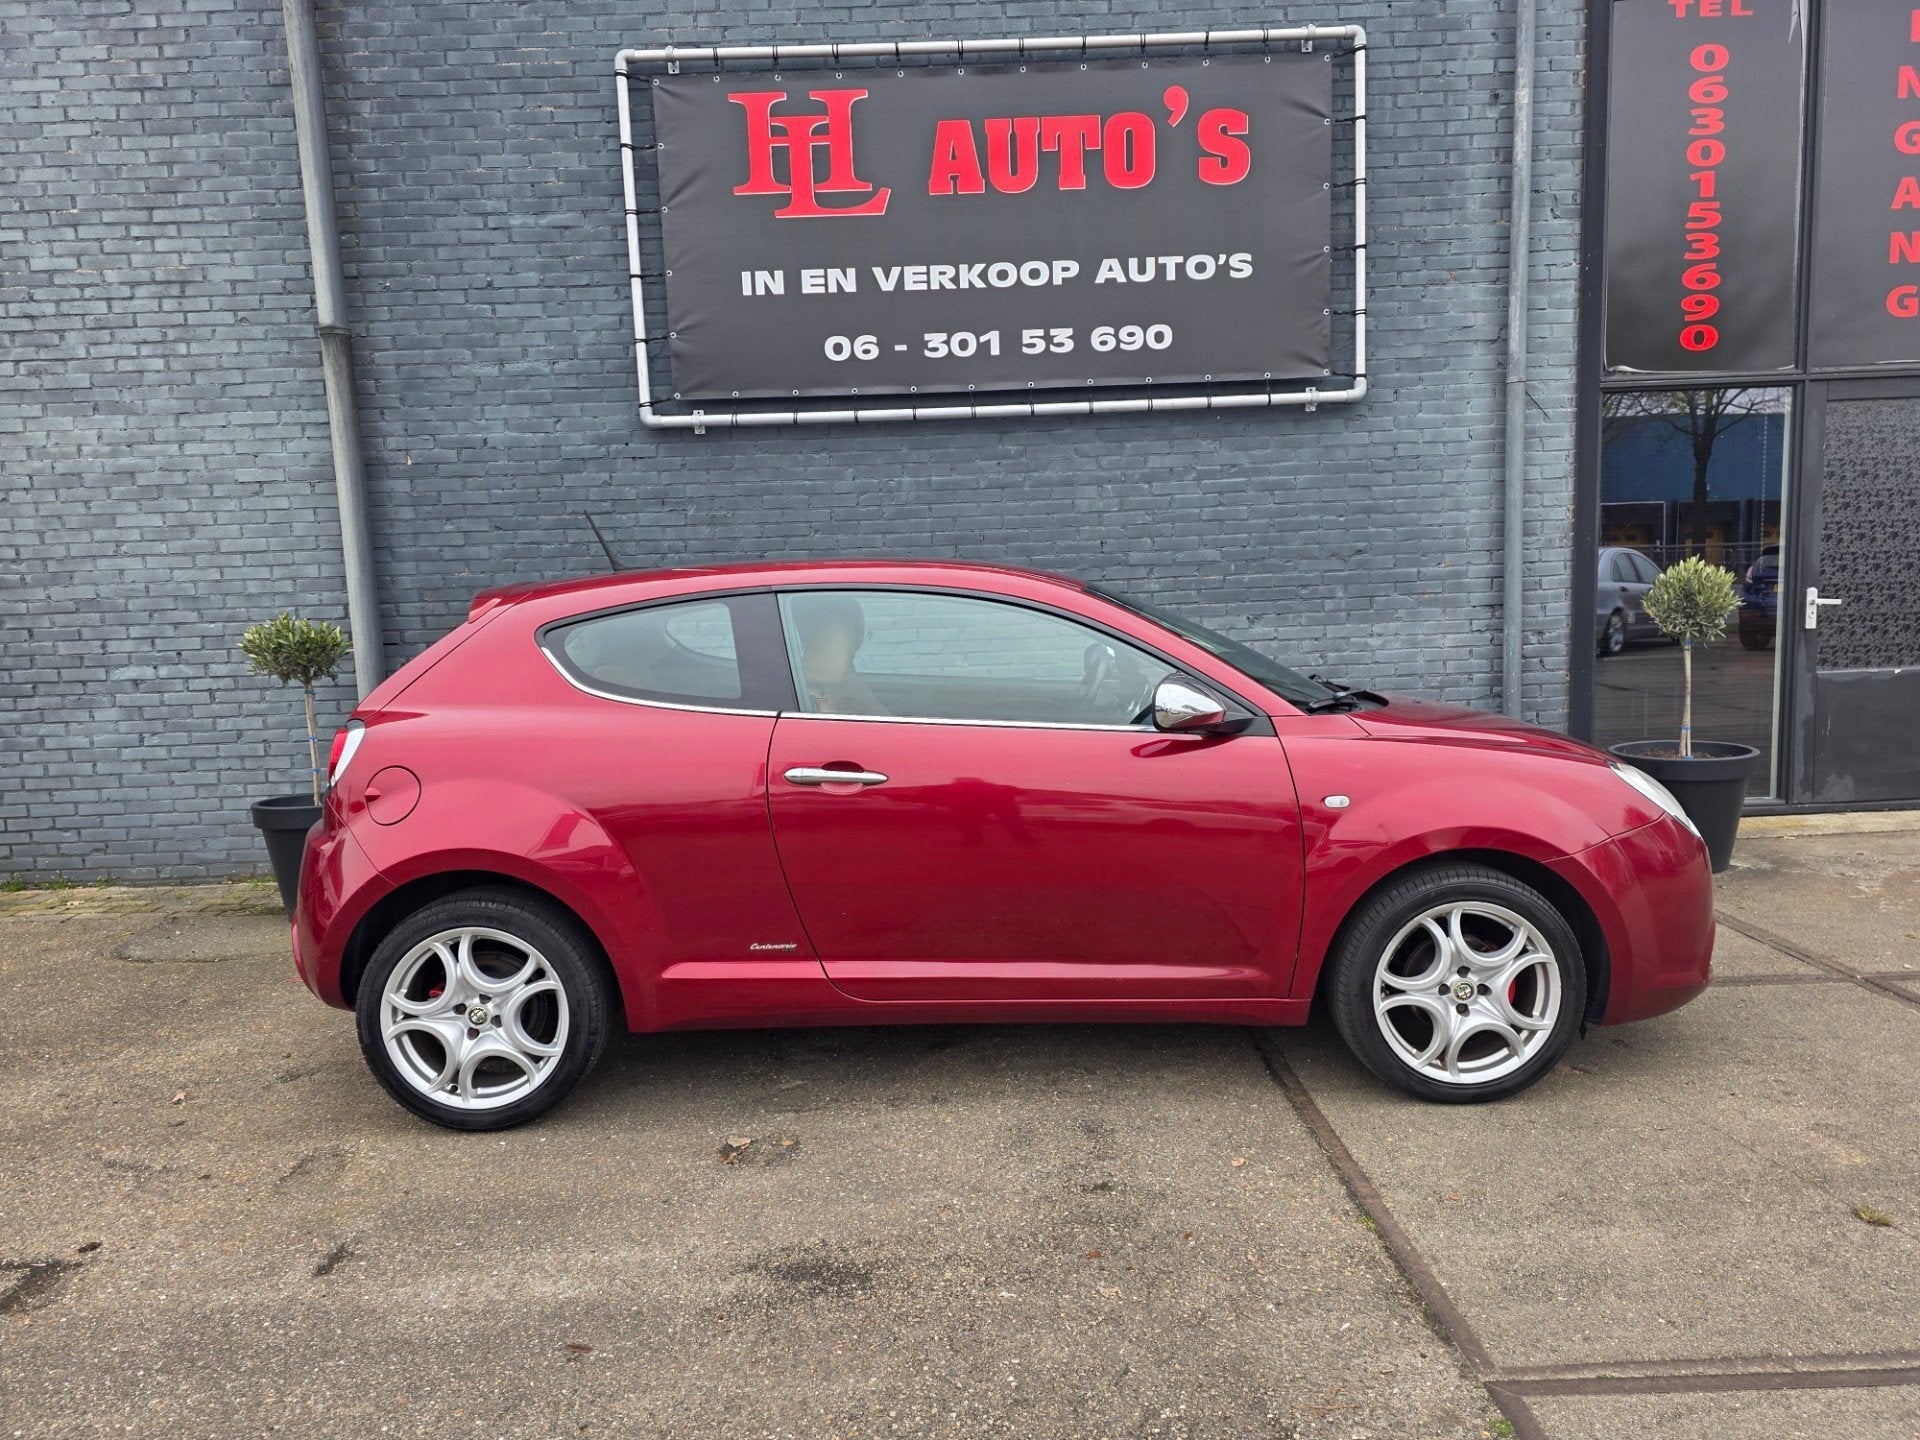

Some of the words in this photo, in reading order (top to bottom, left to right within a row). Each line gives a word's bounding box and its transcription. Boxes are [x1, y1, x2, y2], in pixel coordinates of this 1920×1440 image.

[1668, 0, 1753, 18] TEL
[927, 84, 1252, 196] AUTO'S
[1679, 43, 1730, 352] 0630153690
[741, 269, 785, 296] IN
[800, 267, 857, 295] EN
[871, 259, 1080, 292] VERKOOP
[1094, 252, 1254, 285] AUTO'S
[823, 334, 880, 362] 06
[923, 330, 1001, 359] 301
[1020, 327, 1075, 355] 53
[1090, 323, 1173, 352] 690
